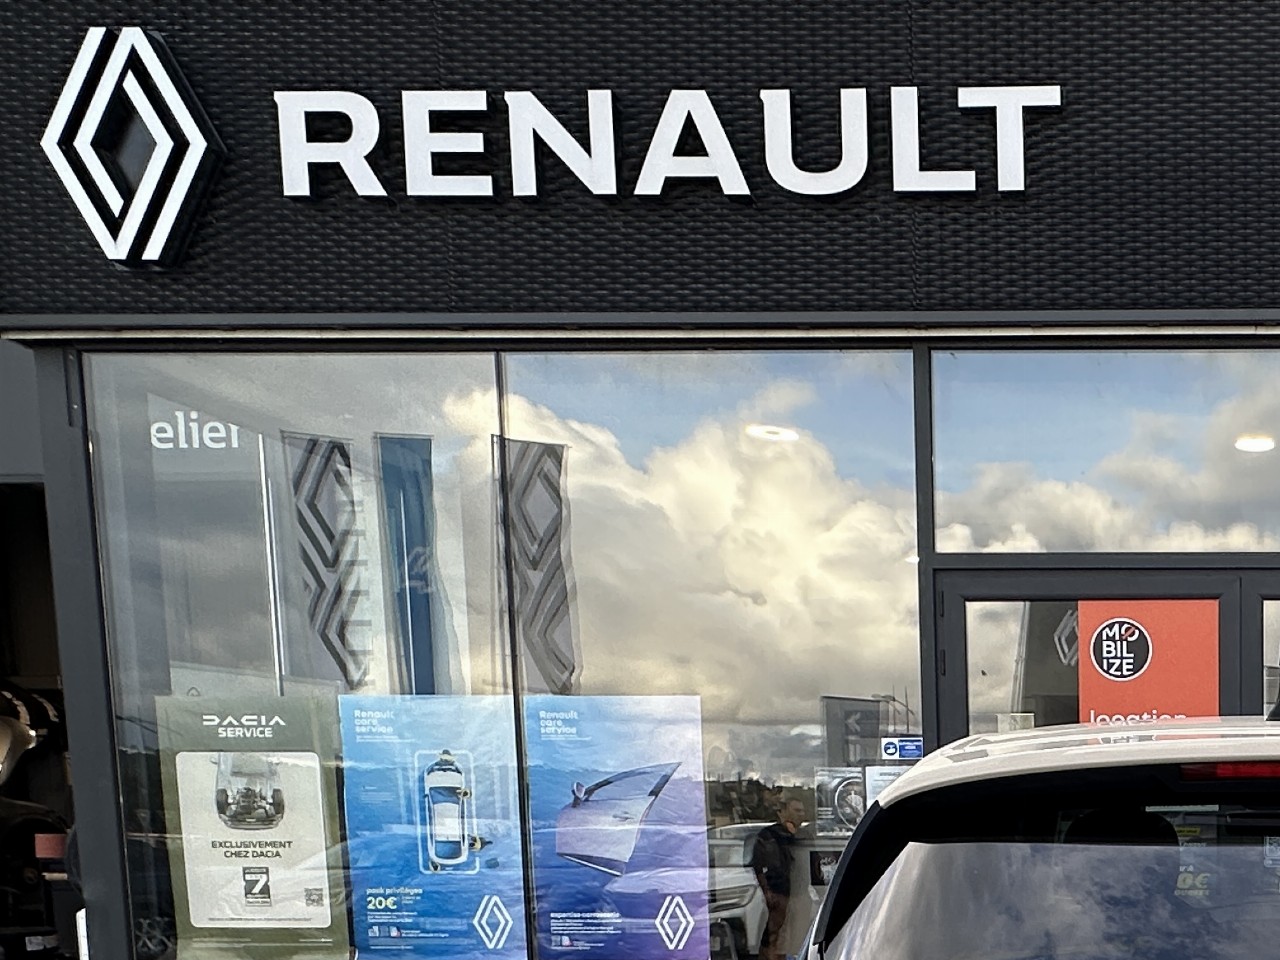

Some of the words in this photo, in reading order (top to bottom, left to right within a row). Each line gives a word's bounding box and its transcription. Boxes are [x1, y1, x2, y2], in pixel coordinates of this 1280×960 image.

[273, 84, 1063, 197] RENAULT
[202, 715, 286, 726] DACIA
[218, 727, 273, 738] SERVICE
[211, 840, 293, 849] EXCLUSIVEMENT
[223, 850, 250, 859] CHEZ
[252, 850, 282, 859] DACIA
[366, 896, 397, 910] 20€
